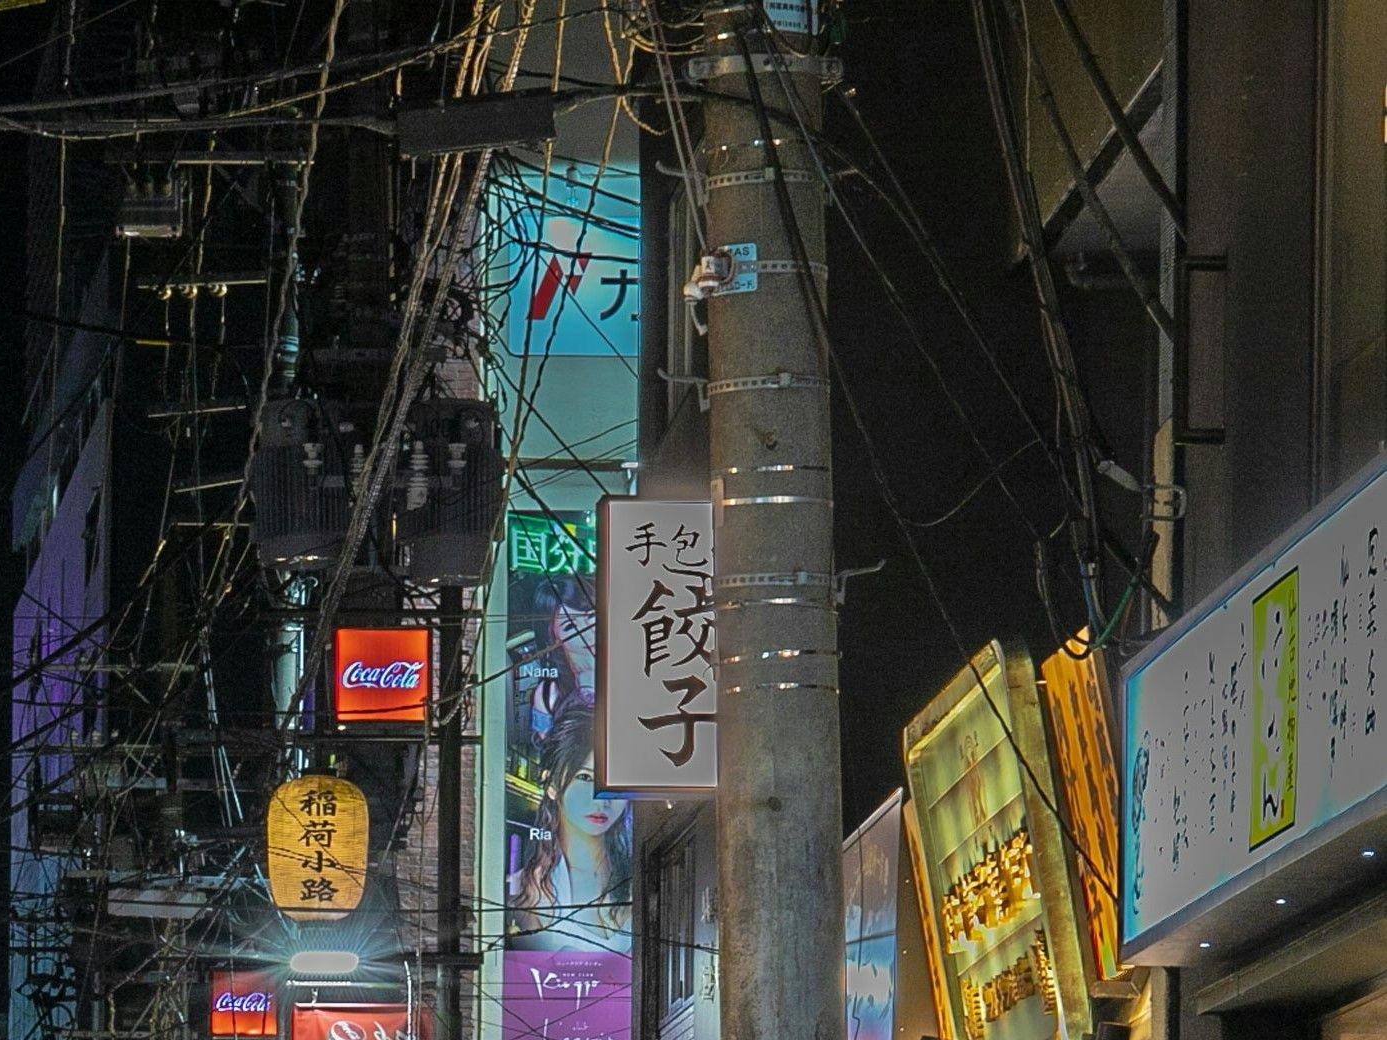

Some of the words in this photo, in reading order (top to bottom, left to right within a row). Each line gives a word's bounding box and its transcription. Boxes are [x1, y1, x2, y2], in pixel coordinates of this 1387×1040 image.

[512, 530, 596, 575] 国分
[341, 661, 424, 689] Coca-Cola
[523, 665, 558, 679] Nana
[298, 789, 339, 903] 稲荷小路
[530, 828, 552, 841] Ria
[215, 992, 273, 1013] Coca-Cola
